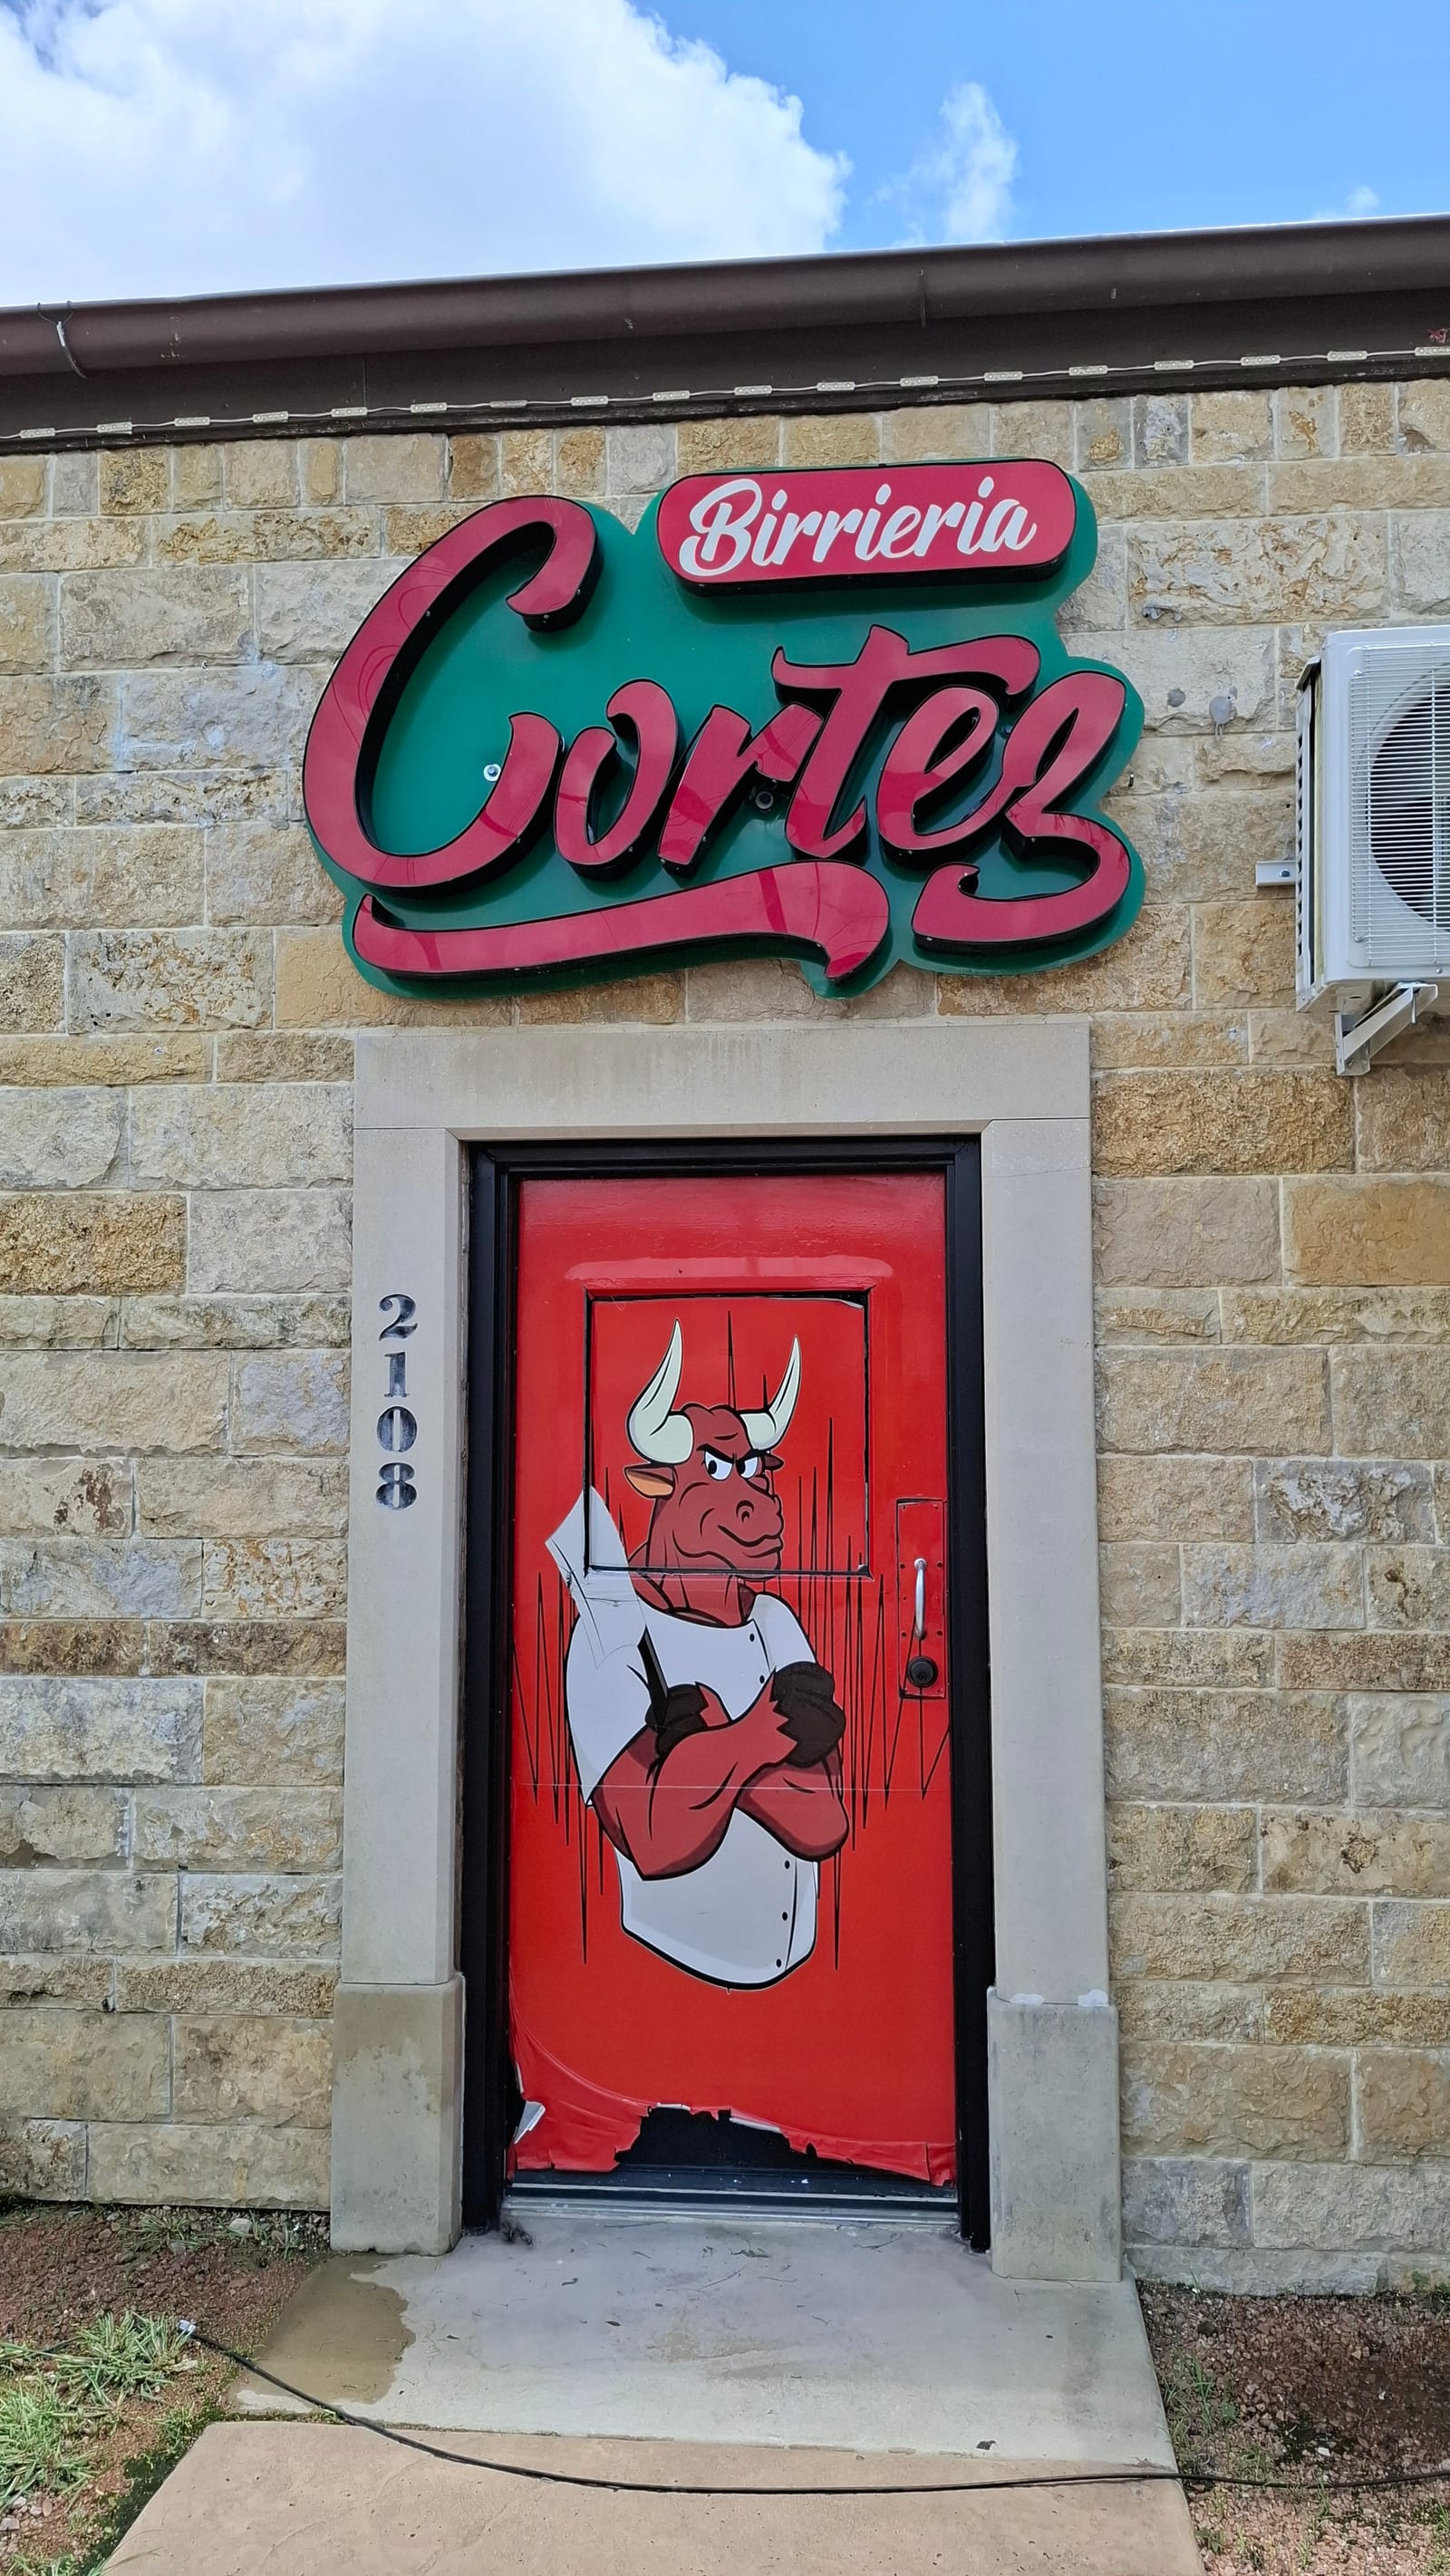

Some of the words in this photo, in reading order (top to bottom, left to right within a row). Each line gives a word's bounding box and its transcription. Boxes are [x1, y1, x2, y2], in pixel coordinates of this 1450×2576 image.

[679, 477, 1037, 576] Birrieria
[303, 495, 1132, 951] Cortez
[375, 1293, 419, 1510] 2108
